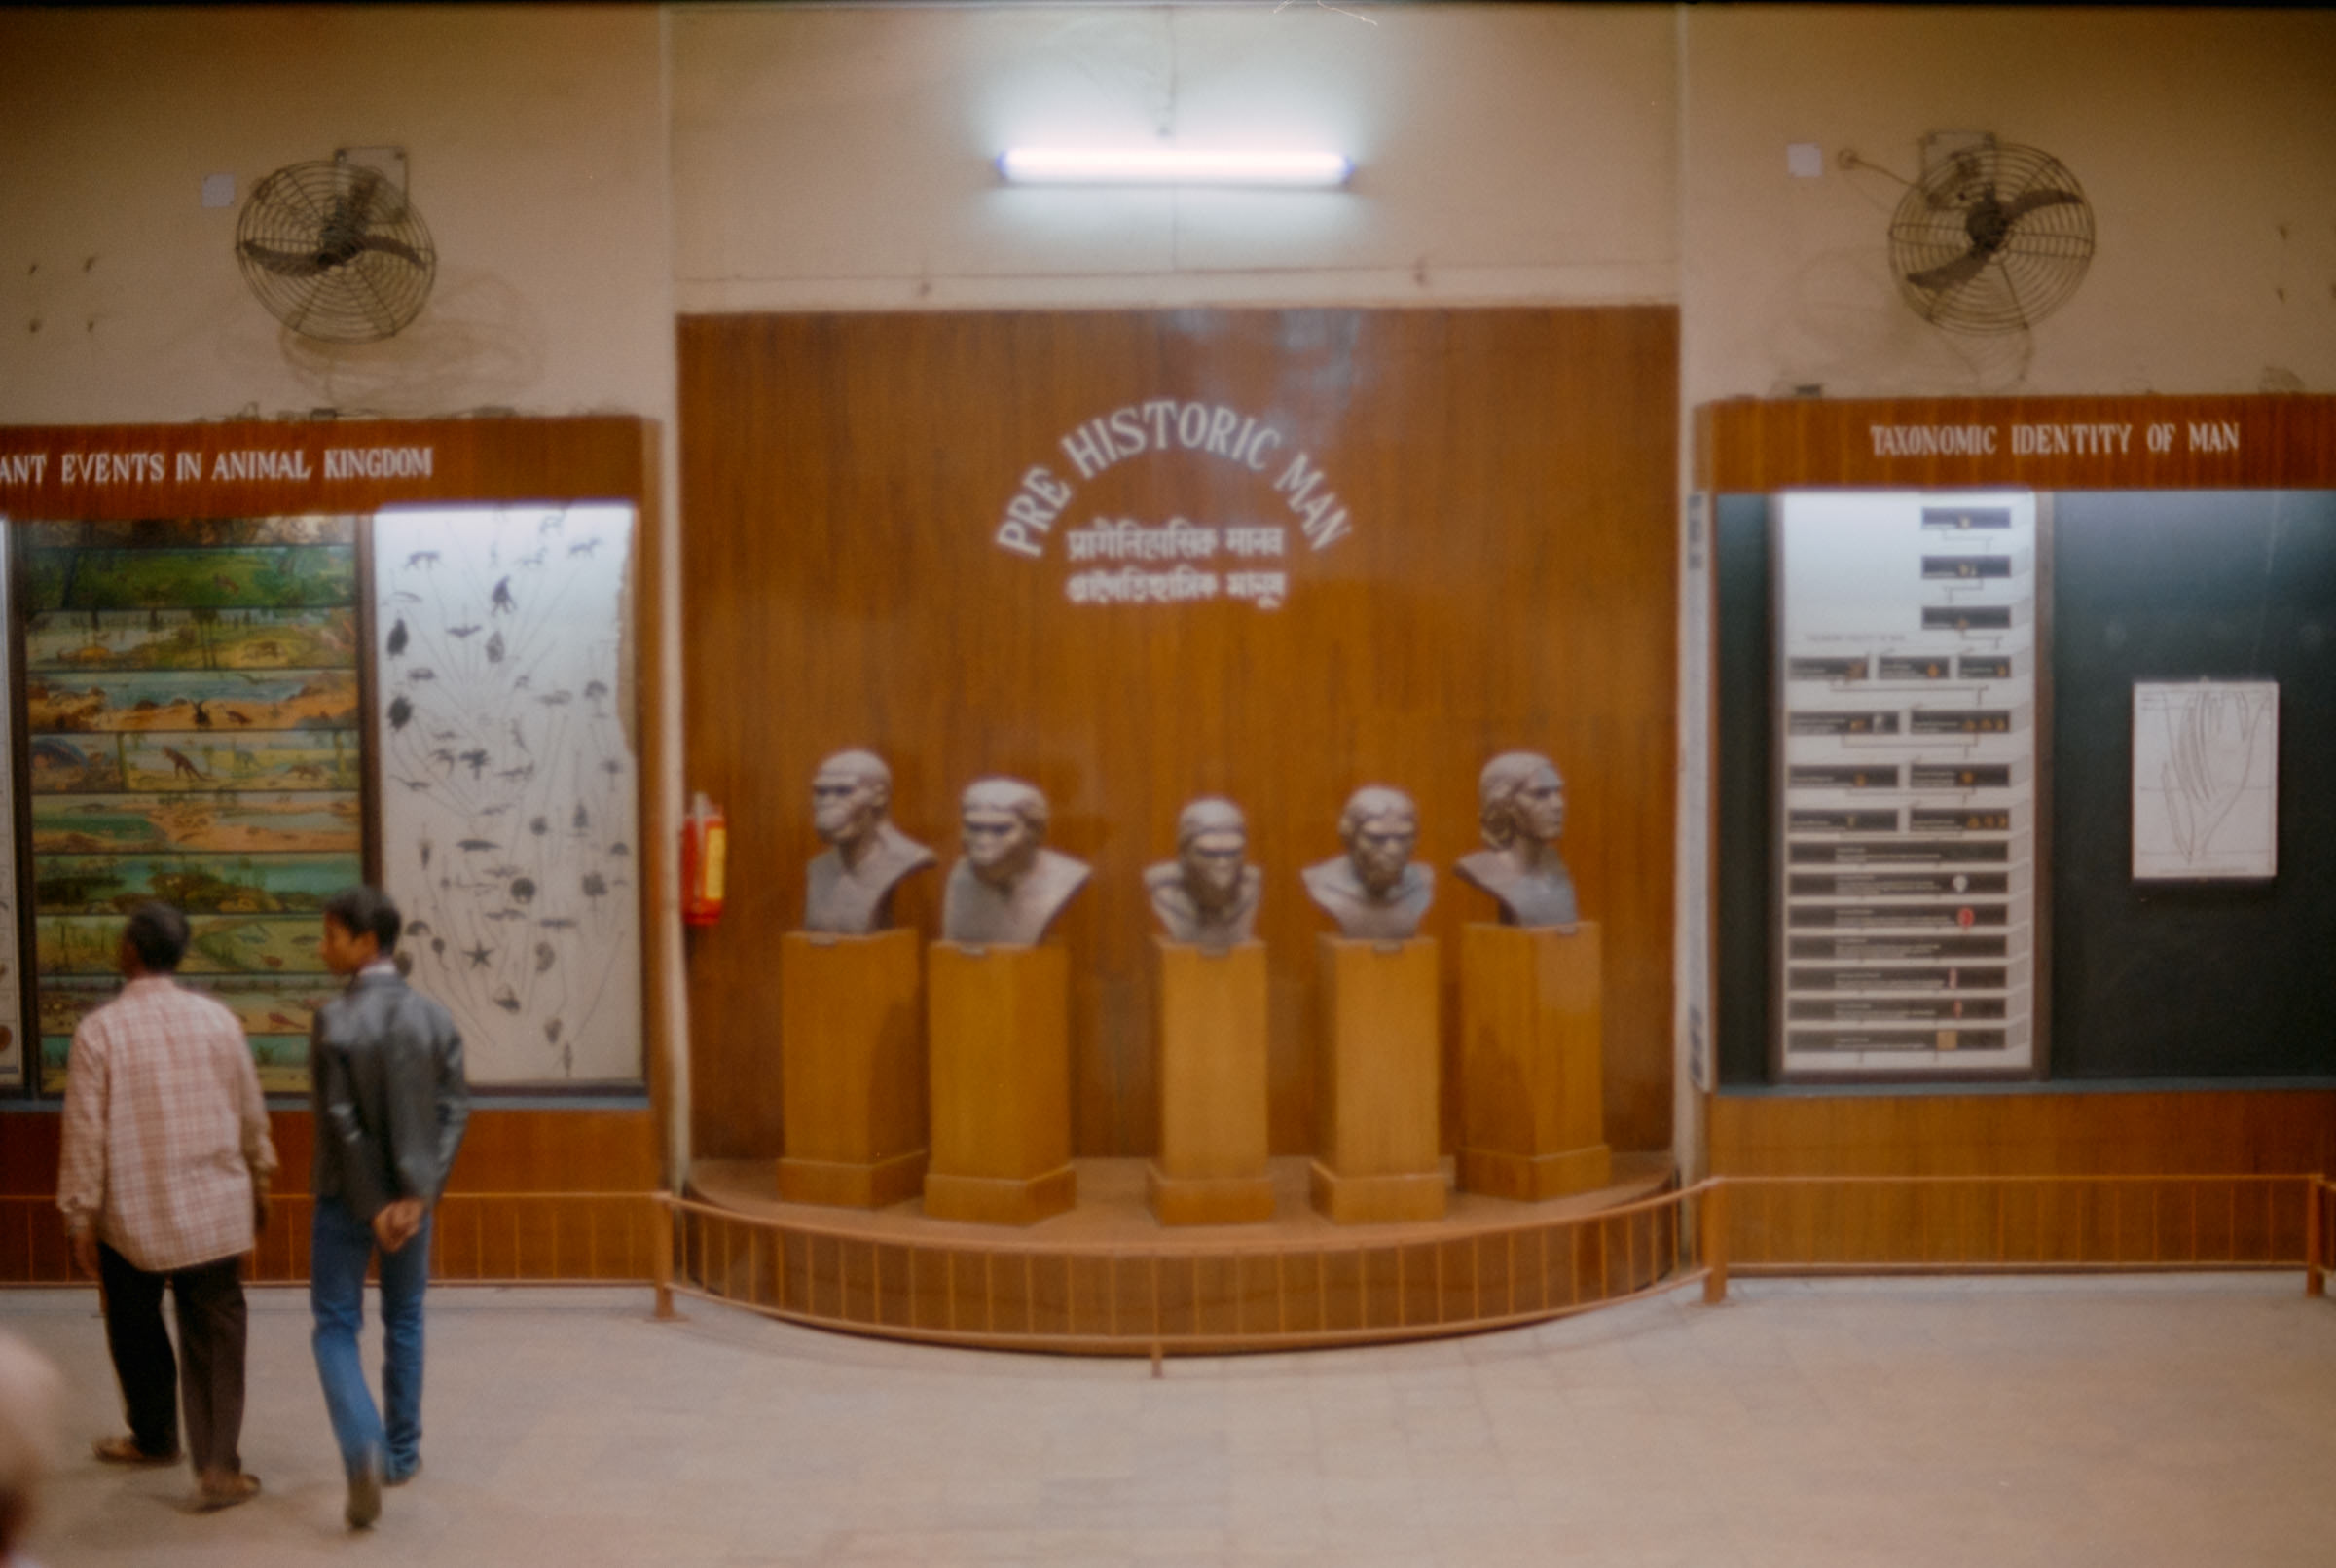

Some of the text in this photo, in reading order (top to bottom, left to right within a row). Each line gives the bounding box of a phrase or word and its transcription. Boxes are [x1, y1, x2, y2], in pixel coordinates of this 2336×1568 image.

[1871, 422, 2239, 456] TAXONOMIC IDENTITY OF MAN
[62, 452, 164, 483] EVENTS
[176, 452, 202, 481] IN
[212, 449, 311, 480] ANIMAL
[324, 447, 433, 479] KINGDOM
[997, 399, 1352, 557] PRE HISTORIC MAN
